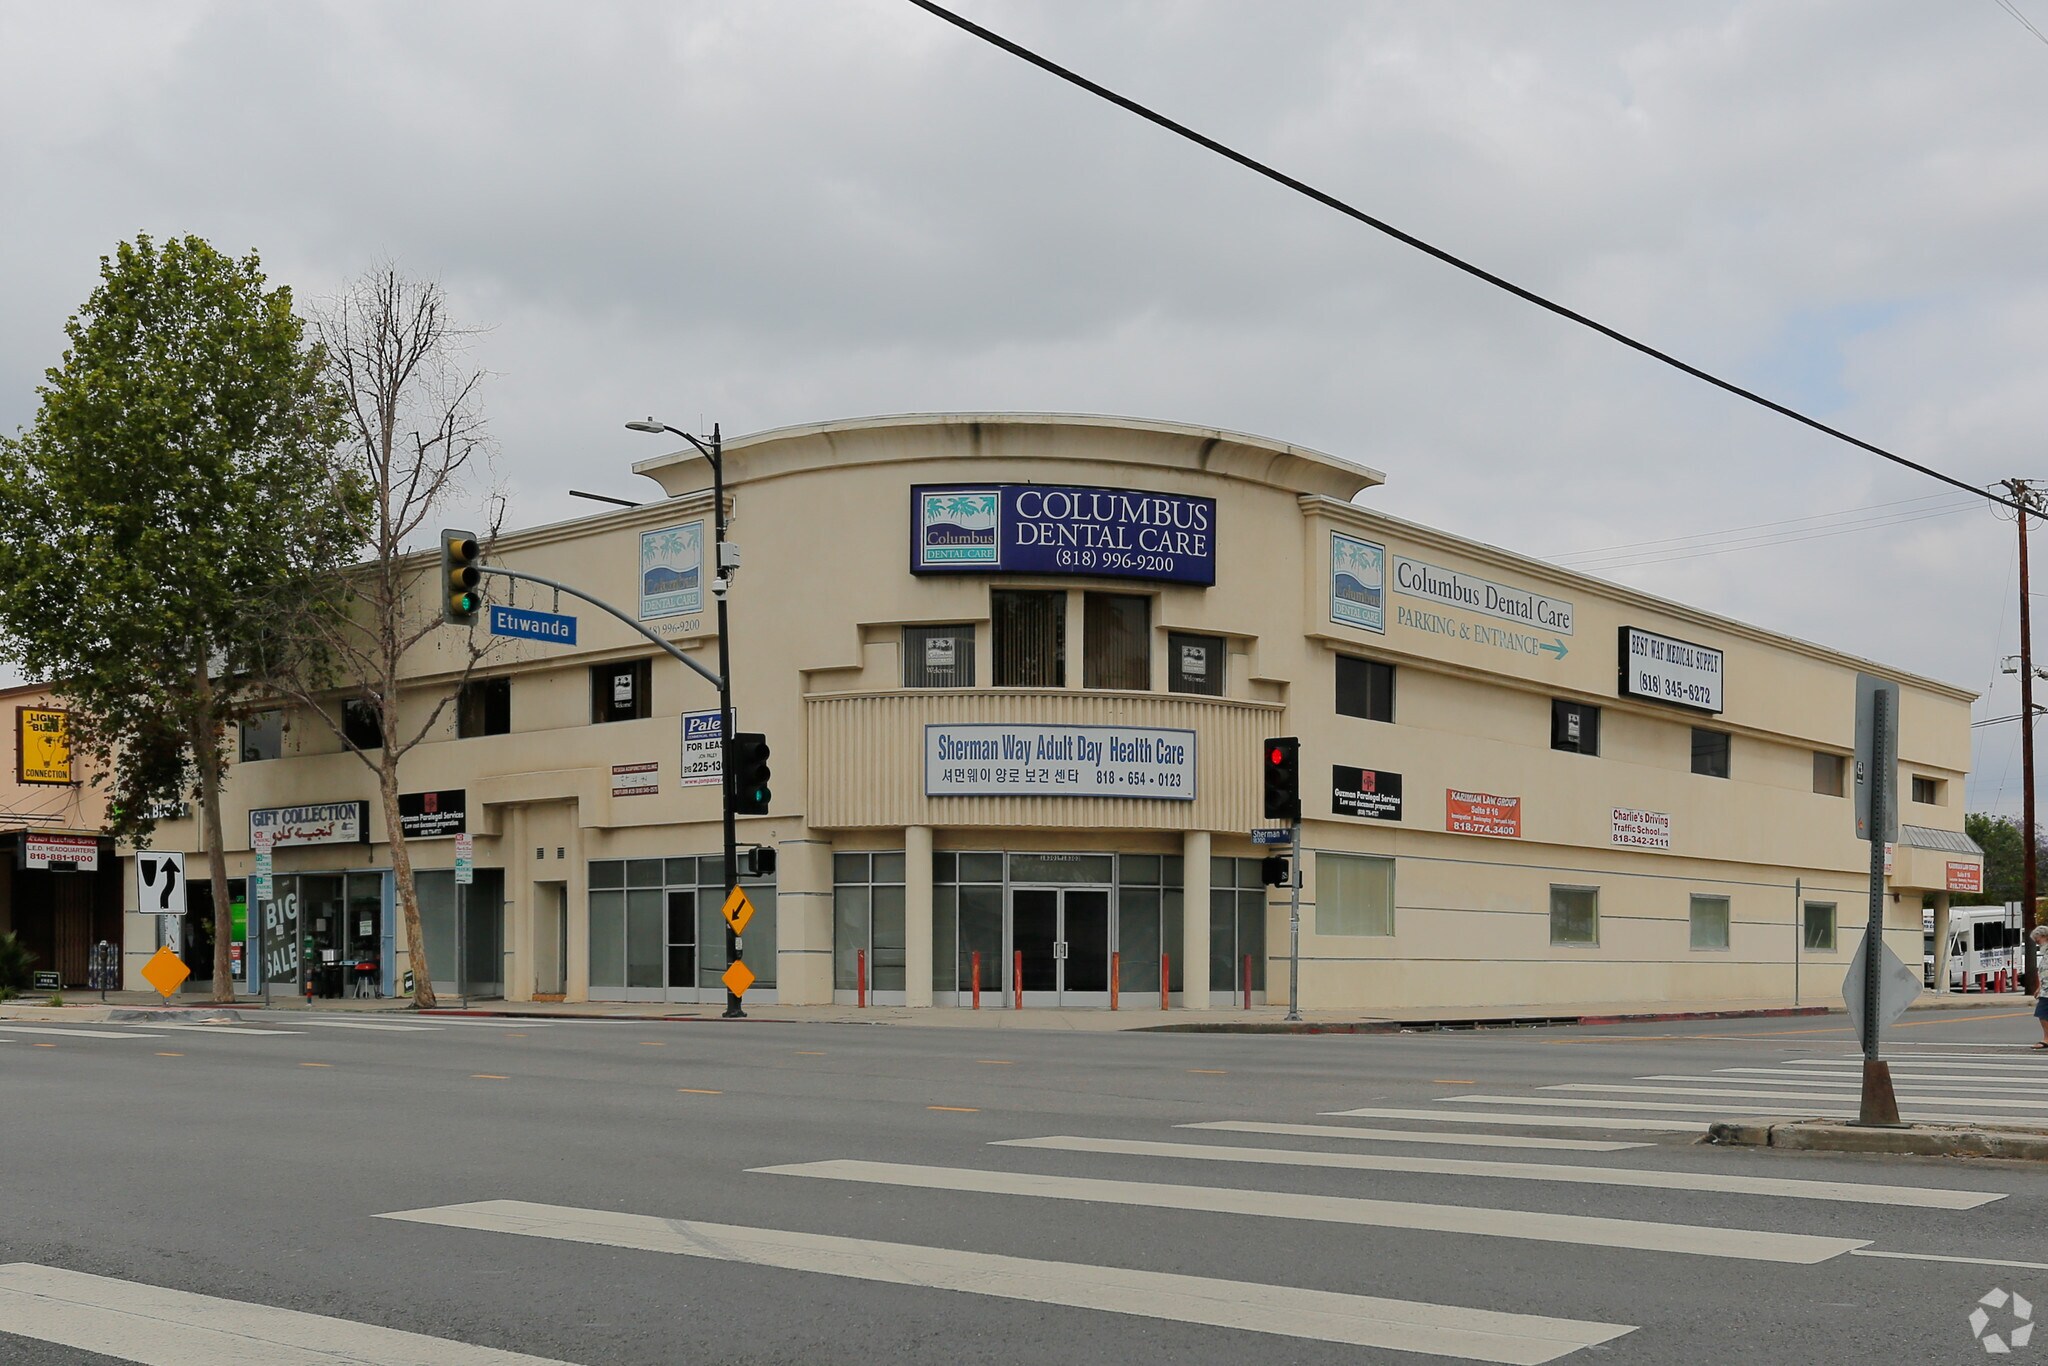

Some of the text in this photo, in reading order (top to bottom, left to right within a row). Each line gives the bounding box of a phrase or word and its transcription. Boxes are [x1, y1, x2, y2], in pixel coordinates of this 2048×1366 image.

[1016, 491, 1208, 531] COLUMBUS
[927, 531, 994, 546] Columbus
[1016, 521, 1208, 558] DENTAL CARE
[927, 549, 993, 560] DENTAL CARE
[1056, 548, 1174, 572] (818) 996-9200
[645, 593, 697, 612] DENTAL CARE
[1398, 562, 1570, 629] Columbus Dental Care
[1336, 603, 1379, 623] DENTAL CARE
[497, 611, 569, 637] Etiwanda
[1398, 606, 1539, 655] PARKING & ENTRANCE
[1632, 634, 1718, 673] BEST WAY MEDICAL SUPPLY
[1640, 670, 1711, 704] (818) 345-8272
[688, 716, 721, 732] Pale
[686, 743, 702, 752] FOR
[938, 734, 1184, 767] Sherman Way Adult Day Health Care
[26, 769, 67, 778] CONNECTION
[942, 768, 1079, 784] 셔먼웨이 양로 보건 센타
[1357, 791, 1380, 803] Paralegal
[1381, 794, 1400, 804] Services
[1482, 795, 1495, 805] LAW
[1497, 798, 1517, 807] GROUP
[252, 804, 357, 826] GIFT COLLECTION
[420, 811, 443, 821] Paralegal
[443, 811, 464, 819] Services
[1471, 806, 1485, 815] Suite
[1613, 810, 1668, 828] Charlie's Driving
[1253, 830, 1280, 838] Sherman
[1454, 822, 1514, 834] 818.774.3400
[1613, 823, 1636, 833] Traffic
[1613, 834, 1668, 847] 818-342-2111
[30, 853, 93, 862] 818-881-1800
[46, 846, 96, 854] HEADQUARTERS
[266, 893, 297, 930] BIG
